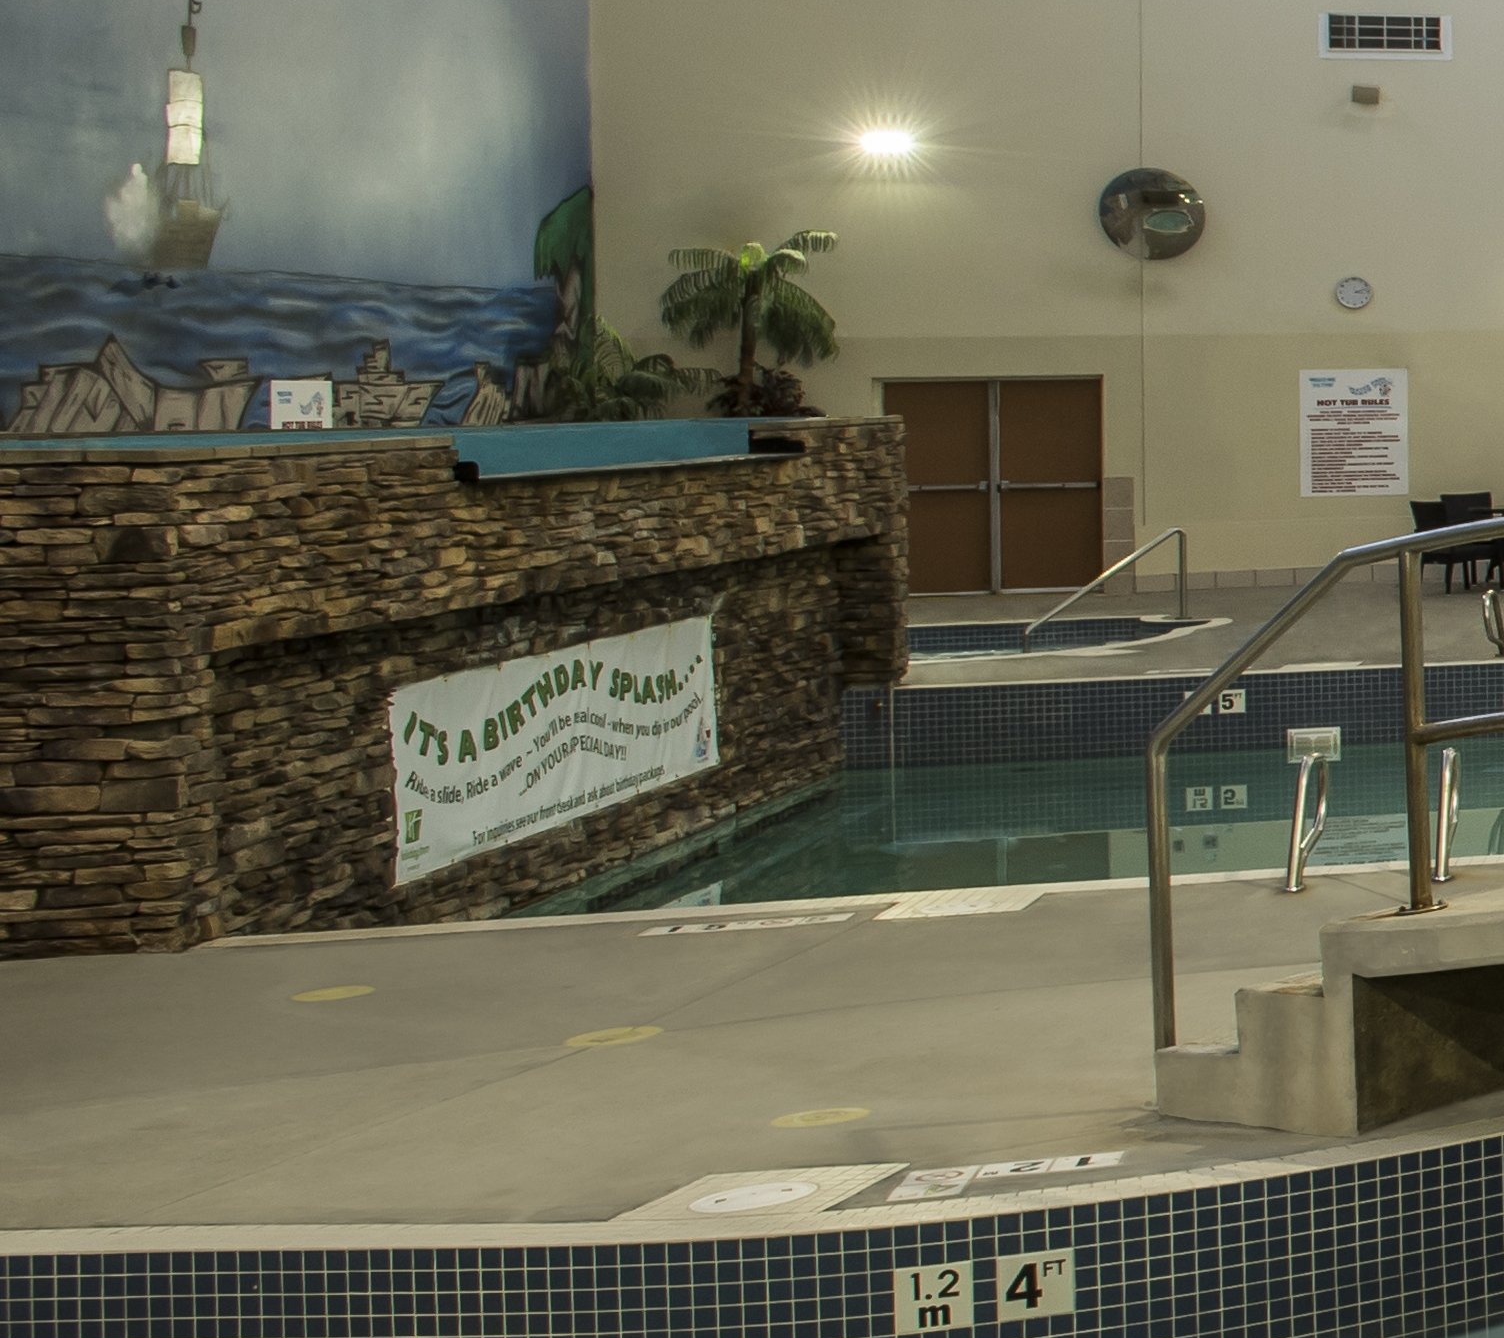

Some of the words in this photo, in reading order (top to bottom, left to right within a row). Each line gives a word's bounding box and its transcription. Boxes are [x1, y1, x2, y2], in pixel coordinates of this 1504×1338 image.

[403, 712, 449, 766] IT'S
[458, 729, 477, 763] A
[484, 659, 604, 751] BIRTHDAY
[466, 777, 489, 799] Ride
[491, 774, 498, 787] a
[499, 755, 522, 781] wave
[558, 715, 572, 730] be
[612, 718, 634, 735] when
[635, 724, 650, 739] you
[541, 742, 570, 775] YOUR
[910, 1269, 960, 1301] 1.2
[918, 1303, 952, 1329] m
